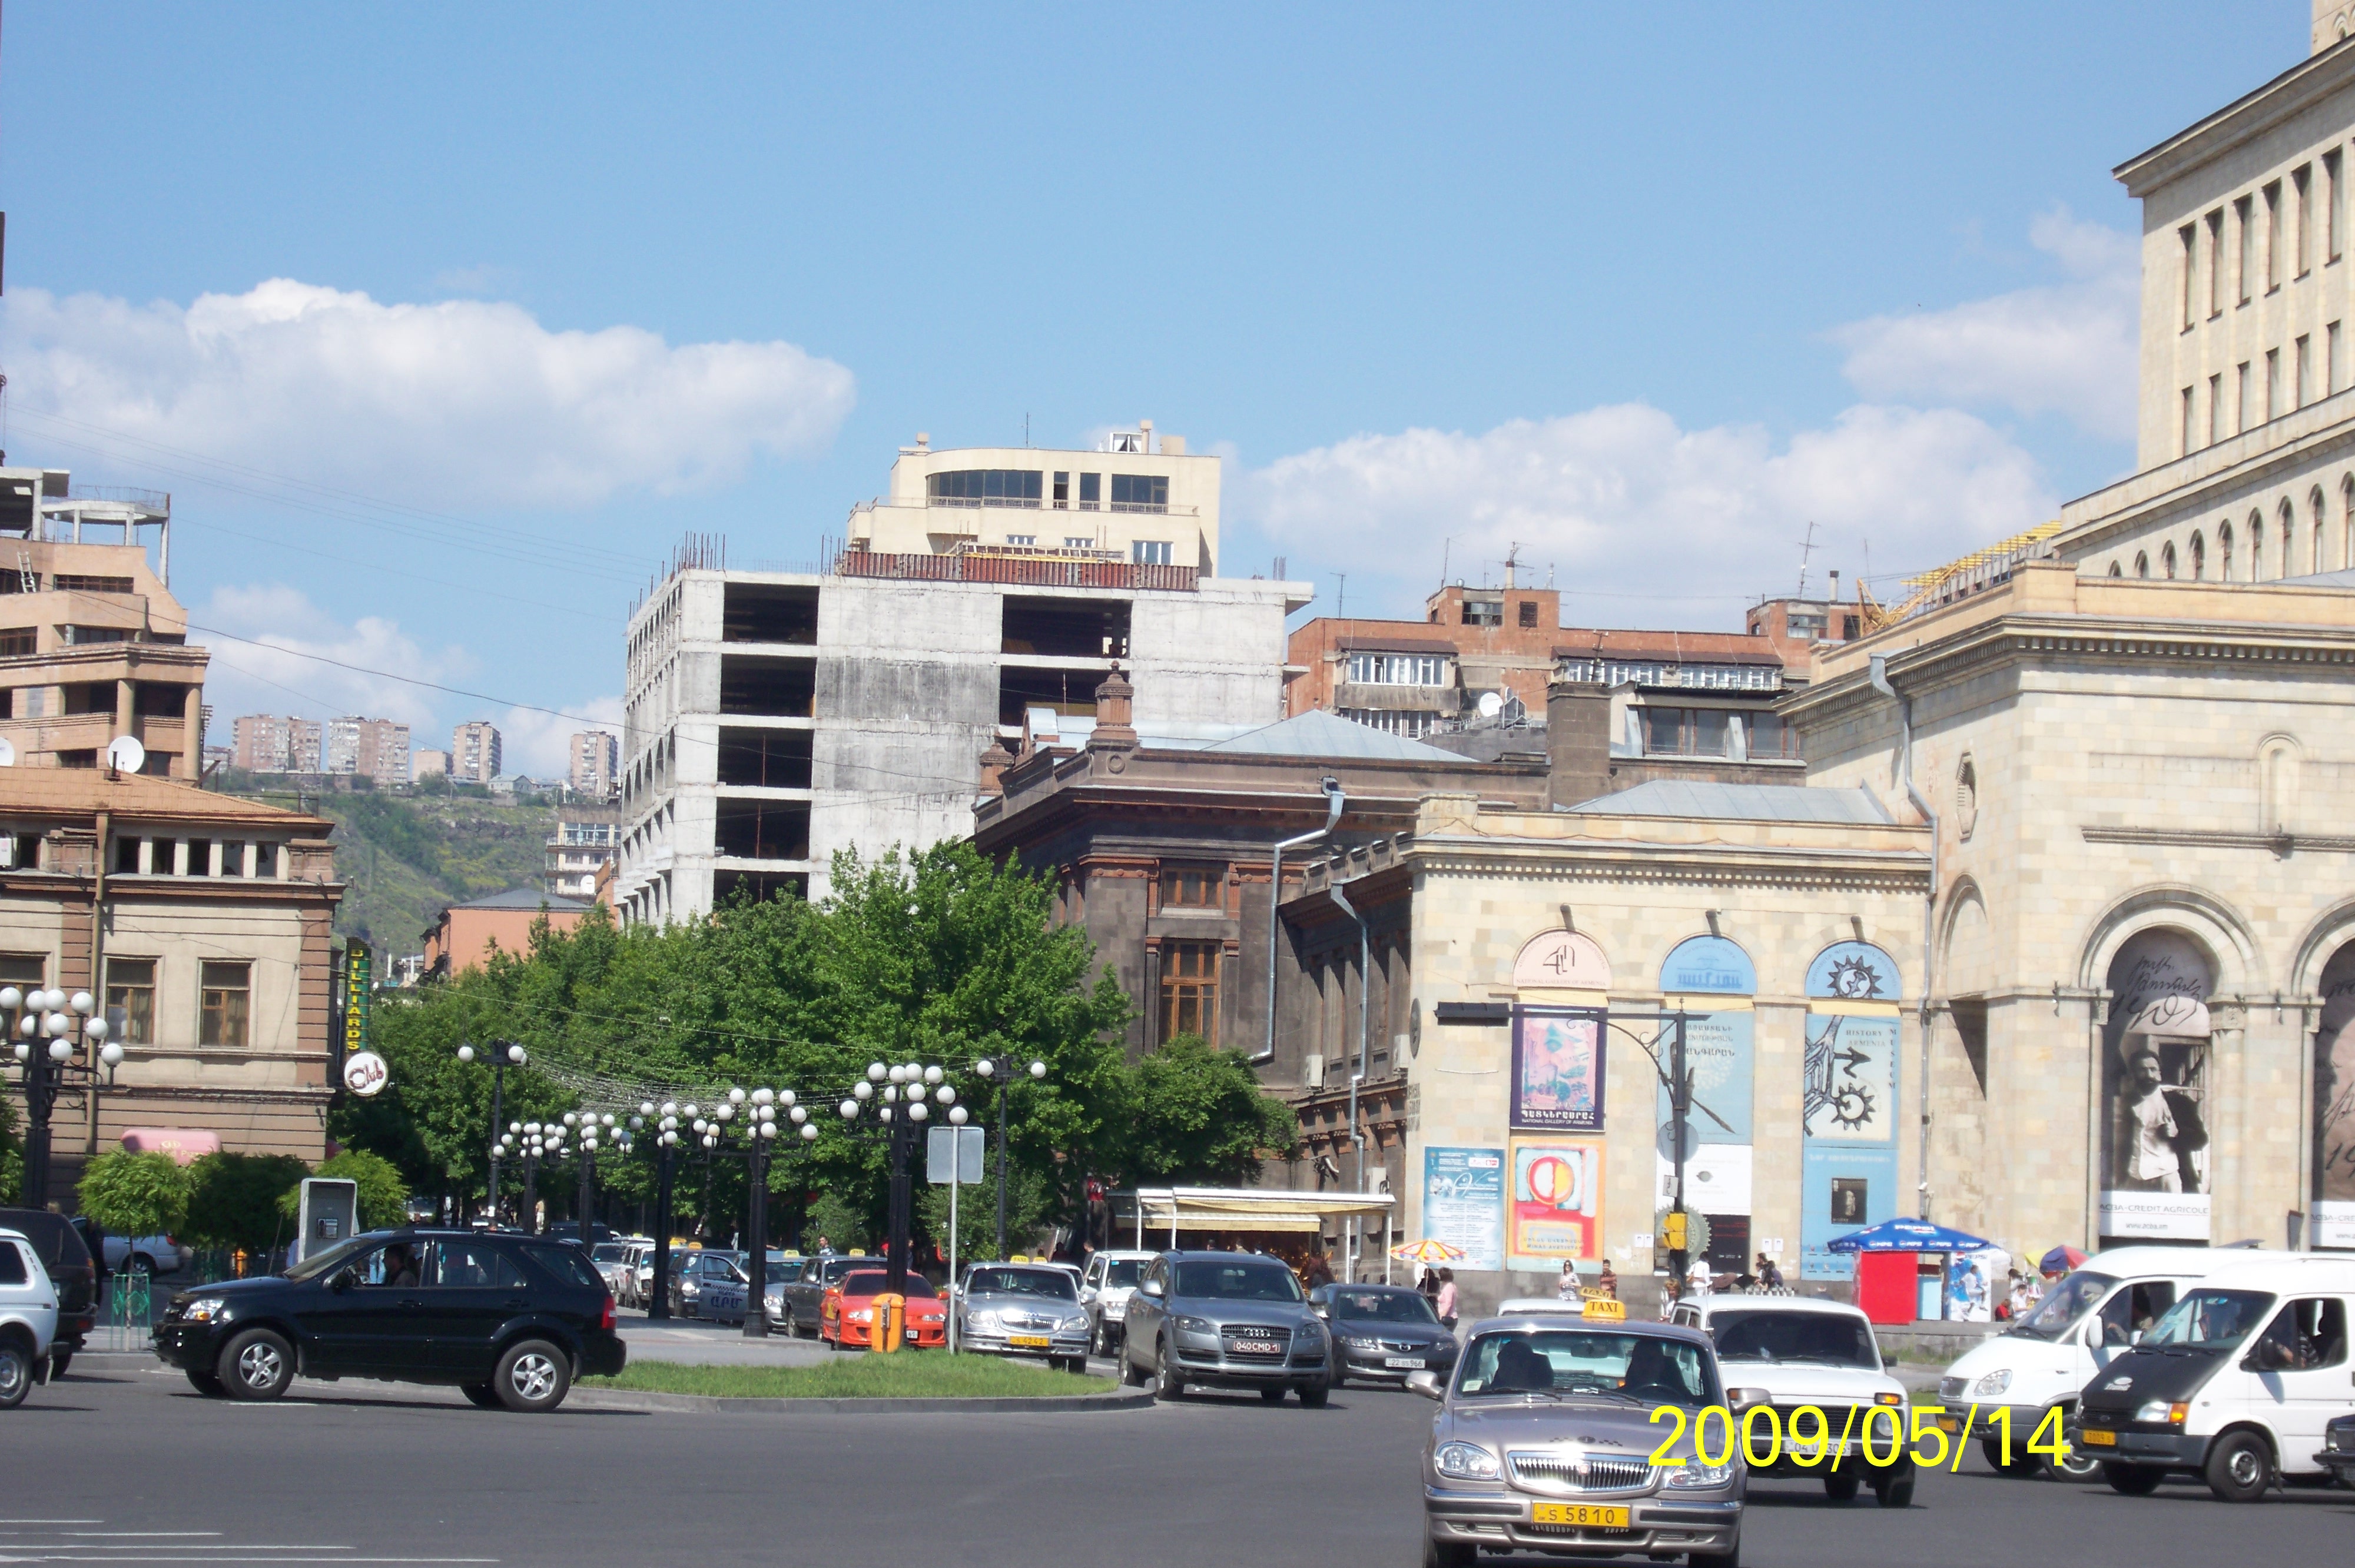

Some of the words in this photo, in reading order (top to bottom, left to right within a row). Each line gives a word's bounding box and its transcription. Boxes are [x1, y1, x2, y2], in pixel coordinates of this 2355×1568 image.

[347, 949, 363, 1051] BILLIARDS
[1686, 1048, 1734, 1057] ԱՆԳԱՐԱՆ
[347, 1059, 384, 1088] Club
[2164, 1205, 2209, 1214] AGRICOLE
[1590, 1301, 1618, 1313] TAXI
[1549, 1509, 1558, 1521] S
[1565, 1507, 1615, 1524] 5810
